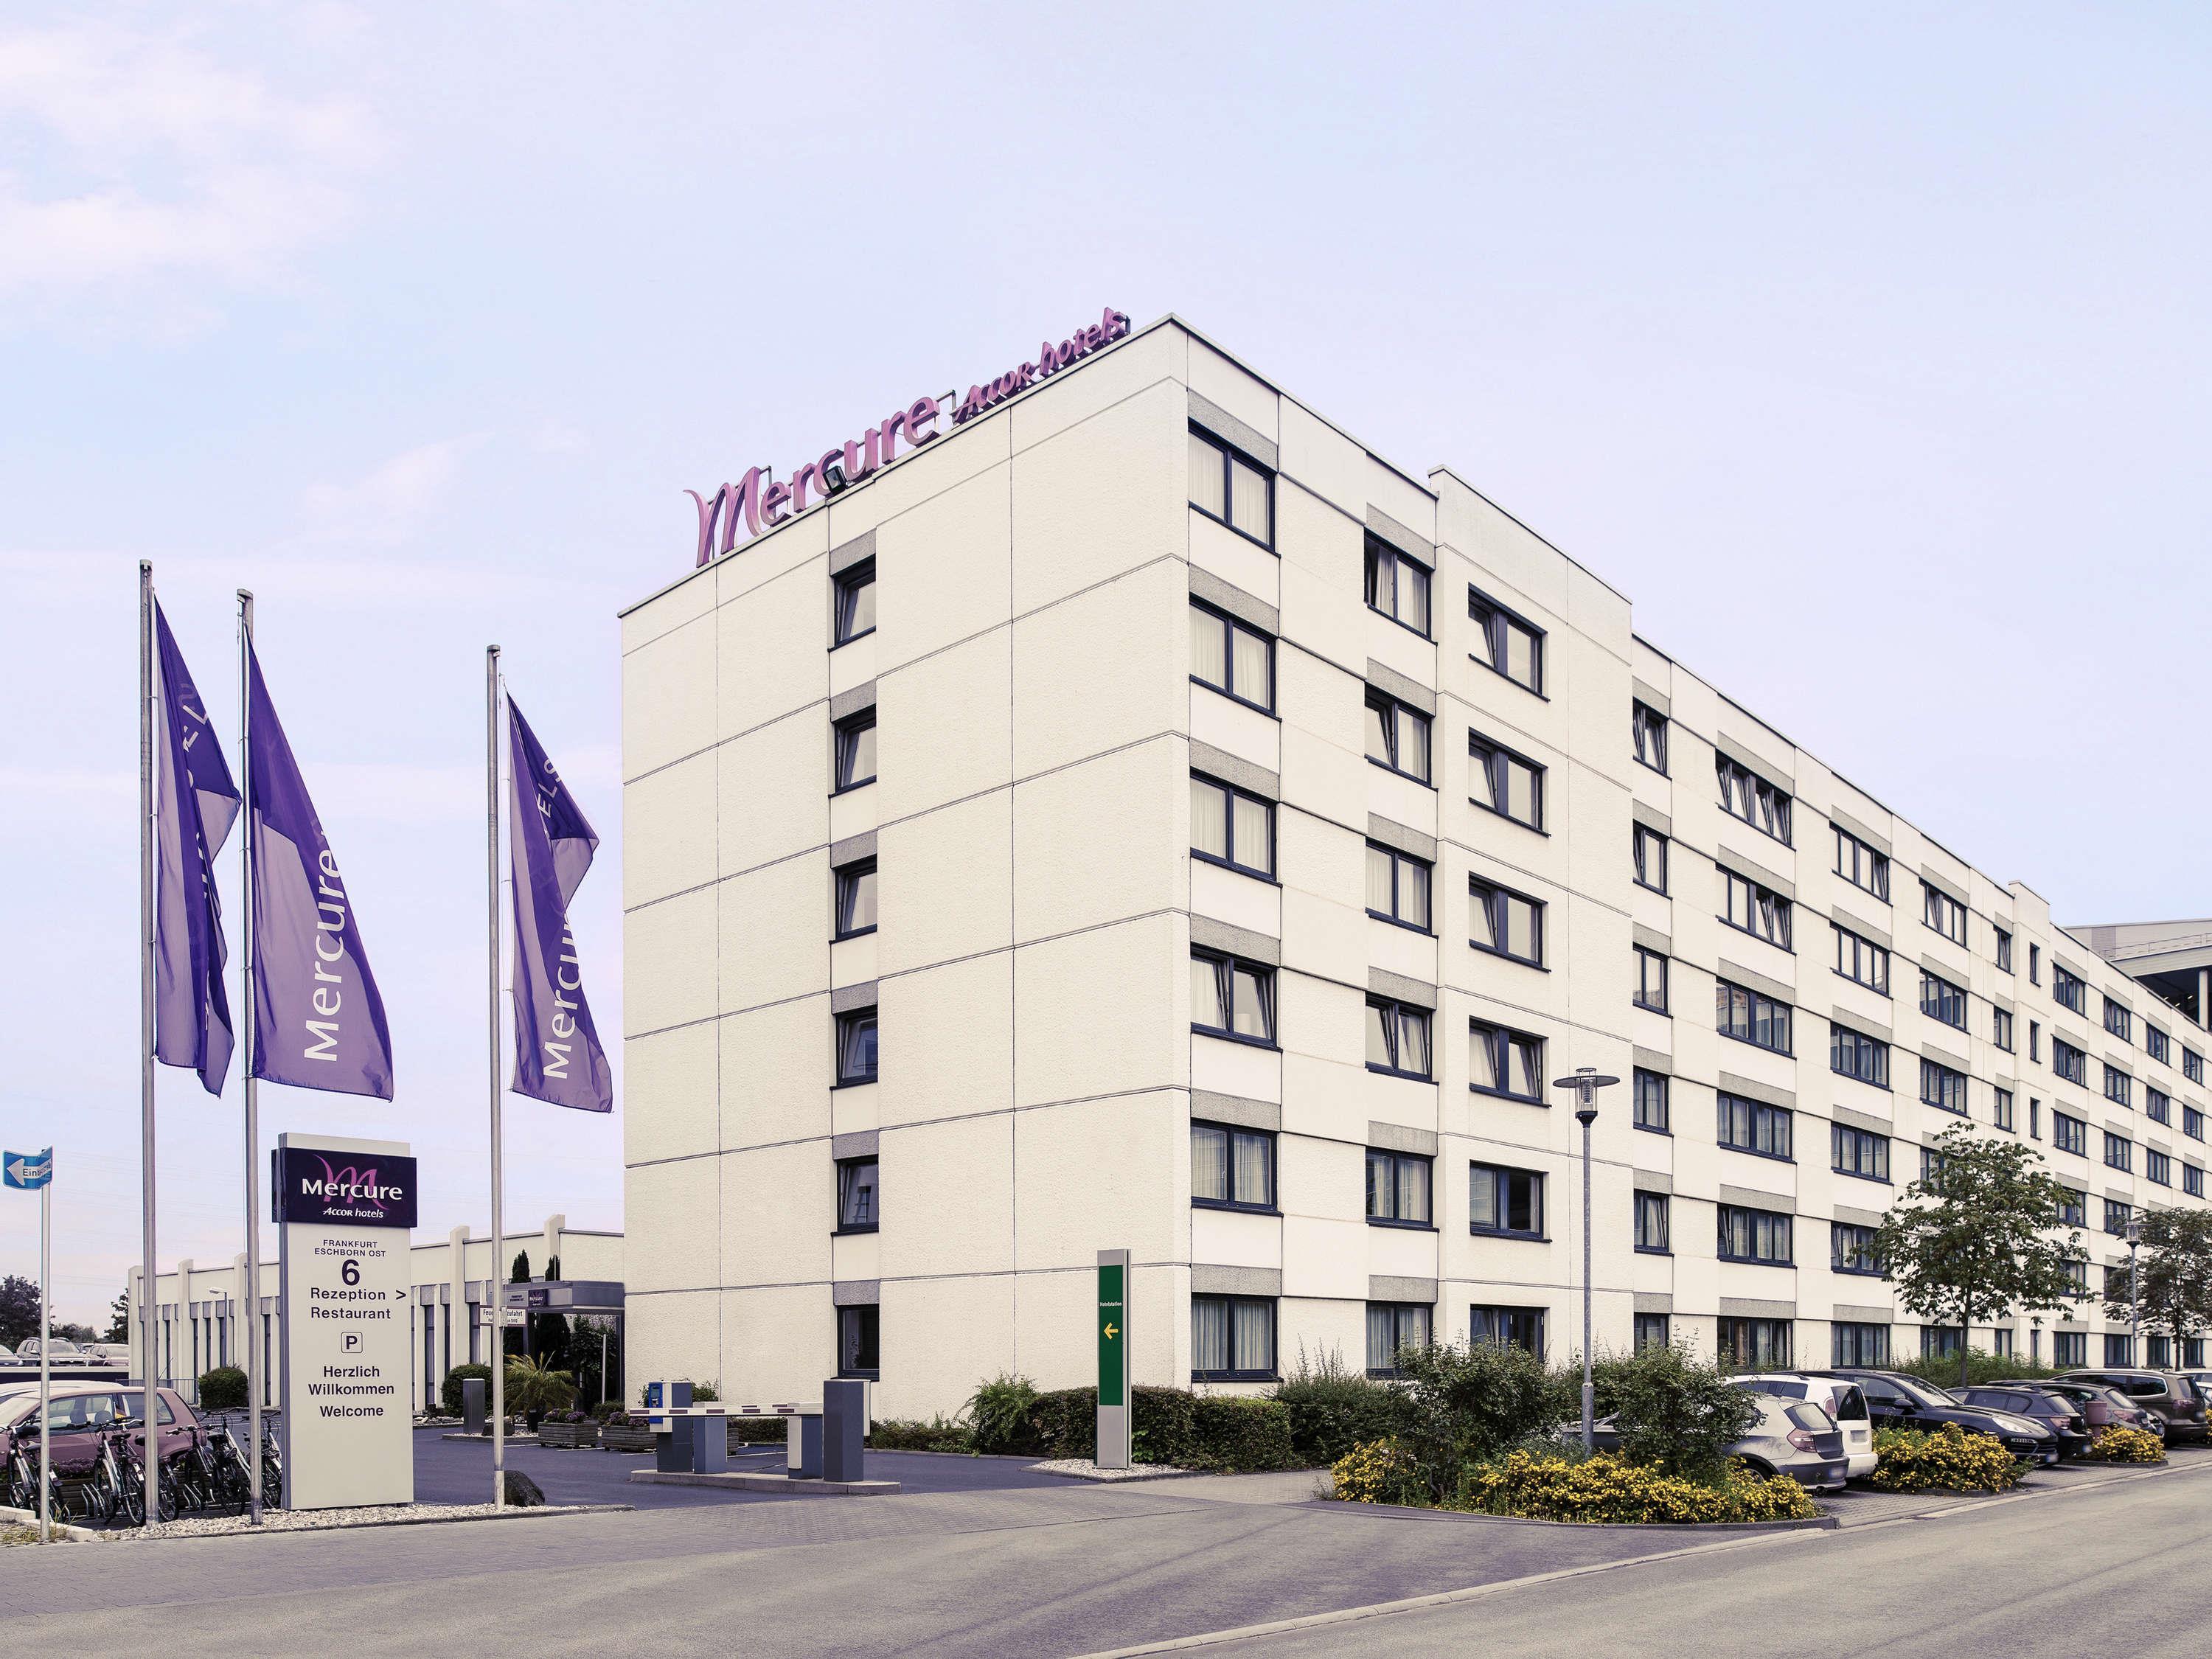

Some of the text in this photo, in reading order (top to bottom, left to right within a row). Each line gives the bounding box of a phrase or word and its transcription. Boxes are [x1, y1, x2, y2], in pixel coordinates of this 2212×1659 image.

[1039, 307, 1127, 376] hotels
[683, 397, 941, 568] Mercure
[304, 849, 346, 1062] Mercure
[543, 912, 582, 1079] Mercu
[302, 1178, 403, 1200] Mercure
[355, 1208, 384, 1218] hotels
[323, 1239, 378, 1248] FRANKFURT
[314, 1248, 366, 1256] ESCHBORN
[341, 1259, 361, 1286] 6
[310, 1287, 386, 1302] Rezeption
[310, 1307, 391, 1319] Restaurant
[346, 1335, 358, 1350] P
[323, 1366, 380, 1377] Herzlich
[308, 1383, 394, 1395] Willkommen
[319, 1405, 384, 1417] Welcome
